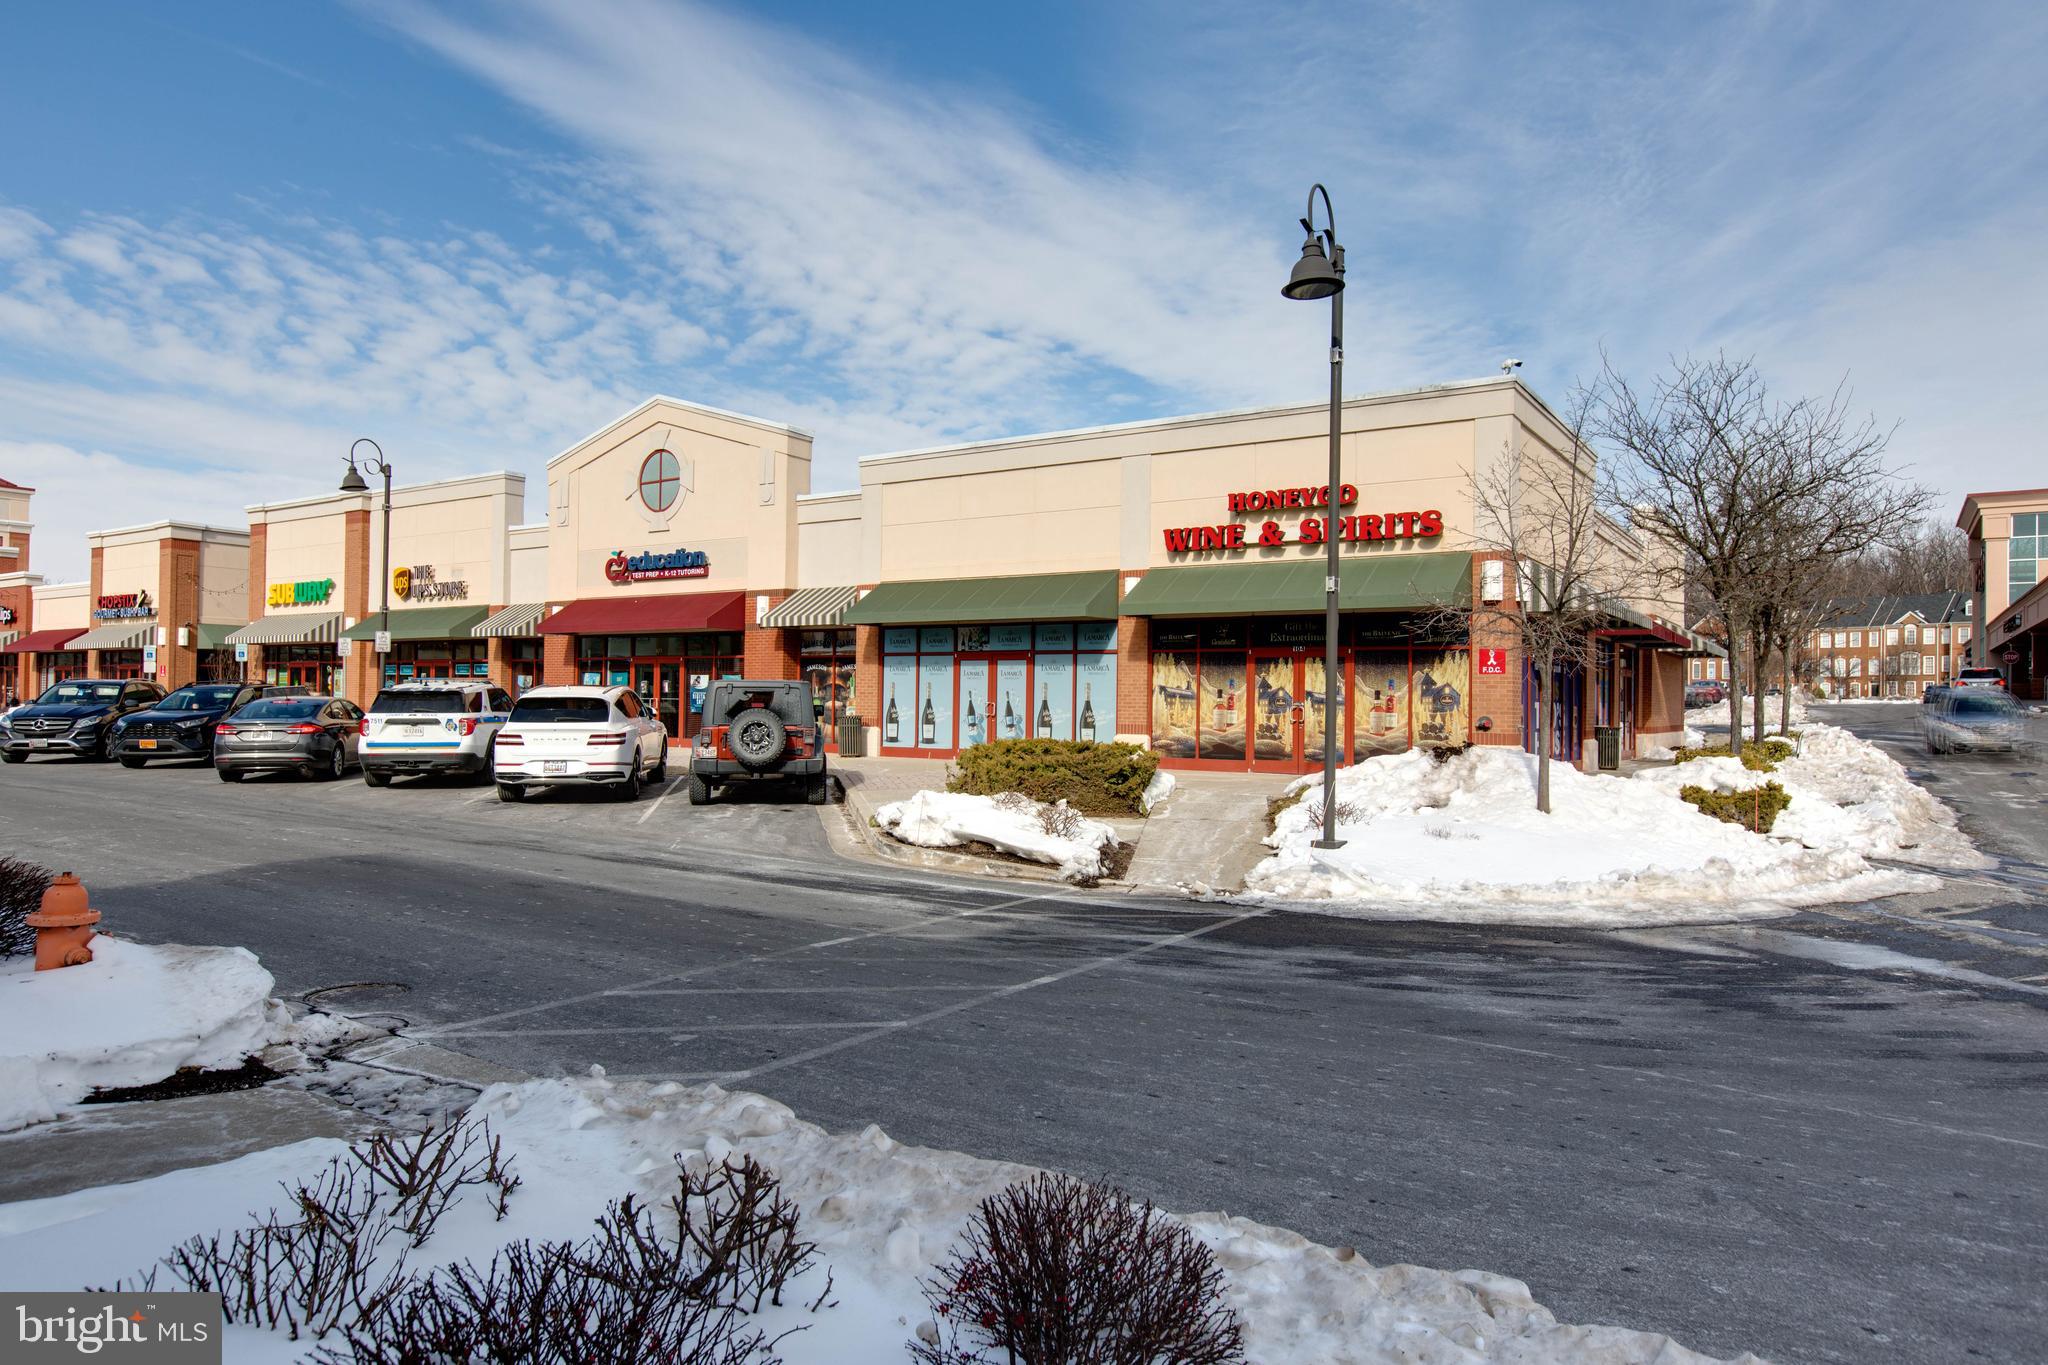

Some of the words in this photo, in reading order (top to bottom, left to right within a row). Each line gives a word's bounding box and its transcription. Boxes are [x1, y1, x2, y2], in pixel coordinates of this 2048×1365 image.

[1227, 484, 1359, 512] HONEYGO
[1163, 524, 1245, 552] WINE
[1258, 521, 1285, 547] &
[1298, 510, 1445, 544] SPIRITS
[628, 548, 705, 571] education
[413, 565, 432, 580] THE
[677, 567, 705, 575] TUTORING
[267, 578, 334, 606] SUBWAY
[395, 577, 408, 593] ups
[411, 583, 431, 598] UPS
[432, 581, 465, 598] STORE
[97, 594, 136, 609] CHOPSTIX
[806, 664, 827, 672] JAMESON
